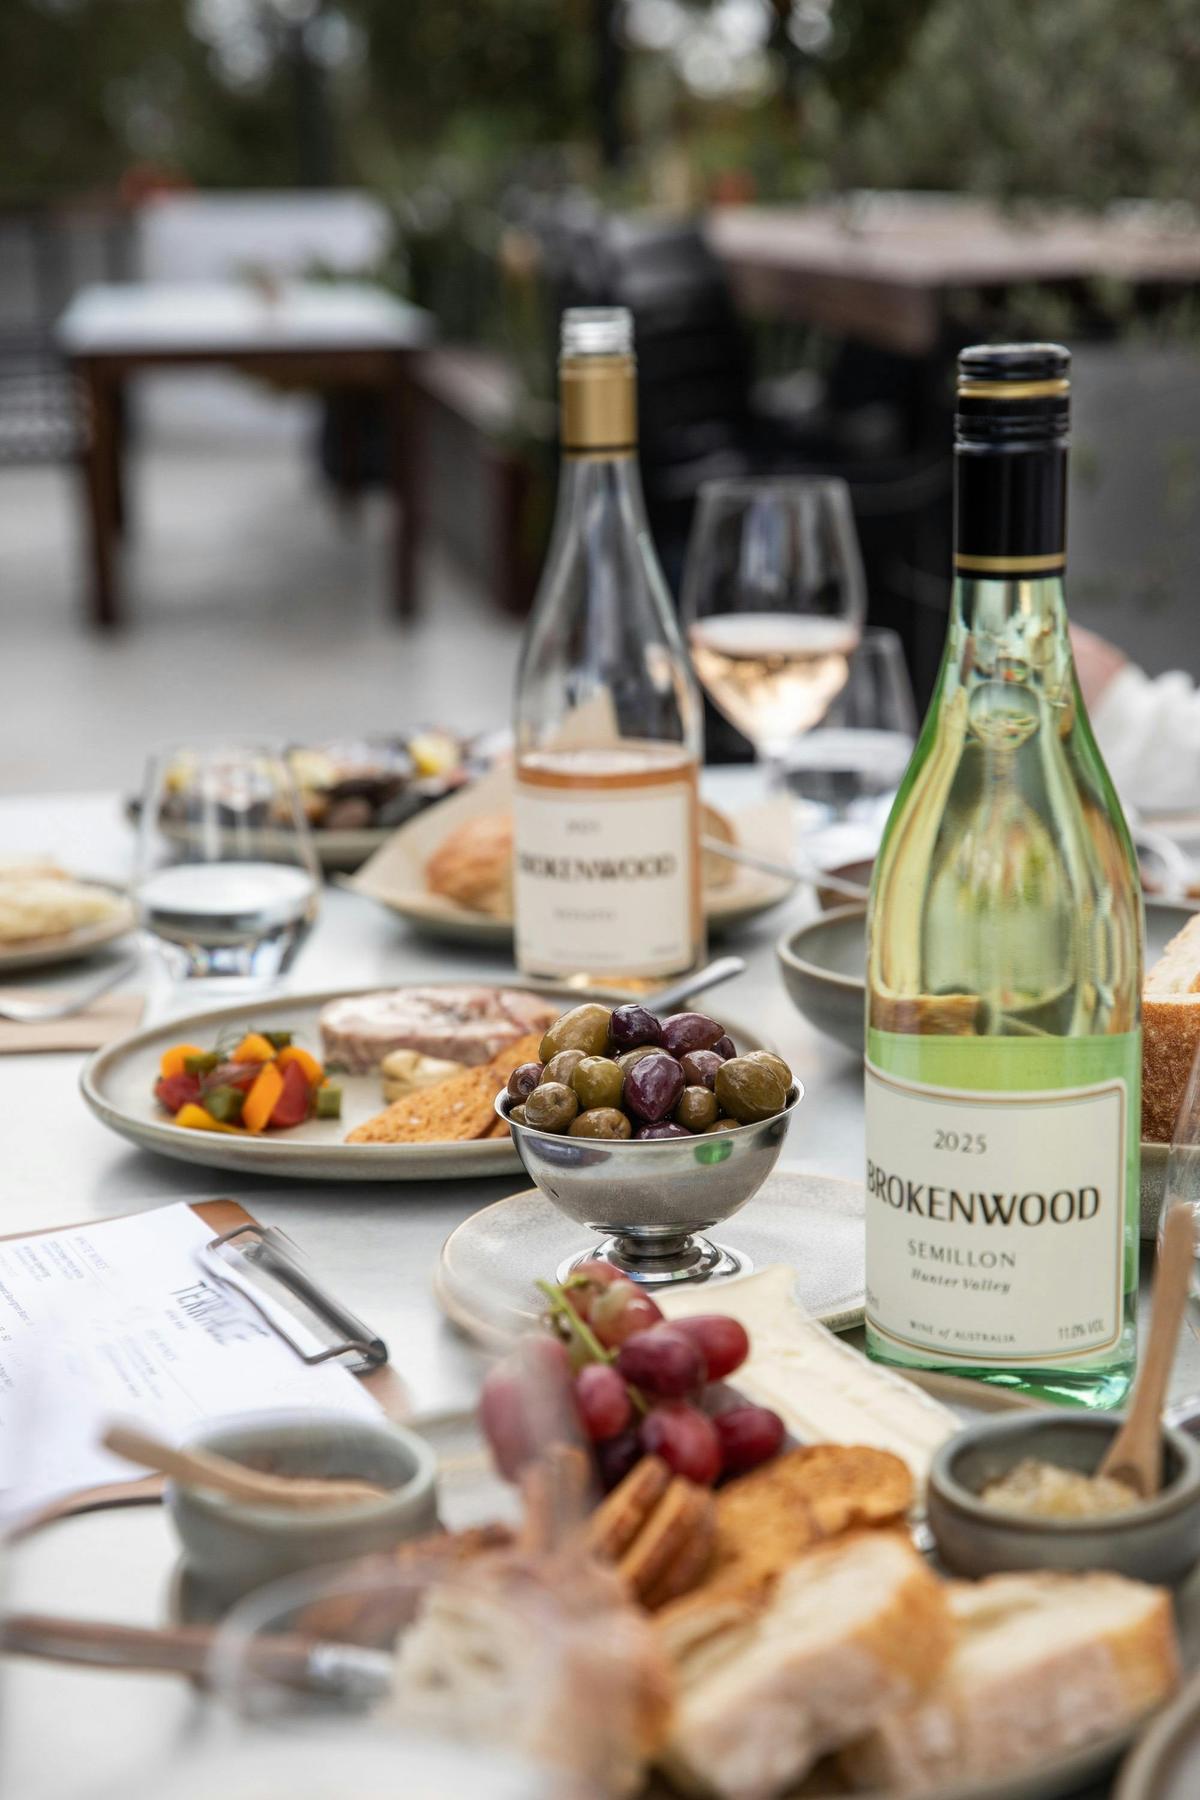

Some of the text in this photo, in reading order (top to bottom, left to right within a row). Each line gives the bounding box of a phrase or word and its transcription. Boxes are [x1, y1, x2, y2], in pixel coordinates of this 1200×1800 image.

[934, 1129, 987, 1154] 2025
[867, 1159, 1102, 1226] BROKENWOOD
[907, 1239, 1016, 1268] SEMILLON
[911, 1268, 1011, 1294] Hunter Valley
[954, 1330, 1016, 1344] AUSTRALIA
